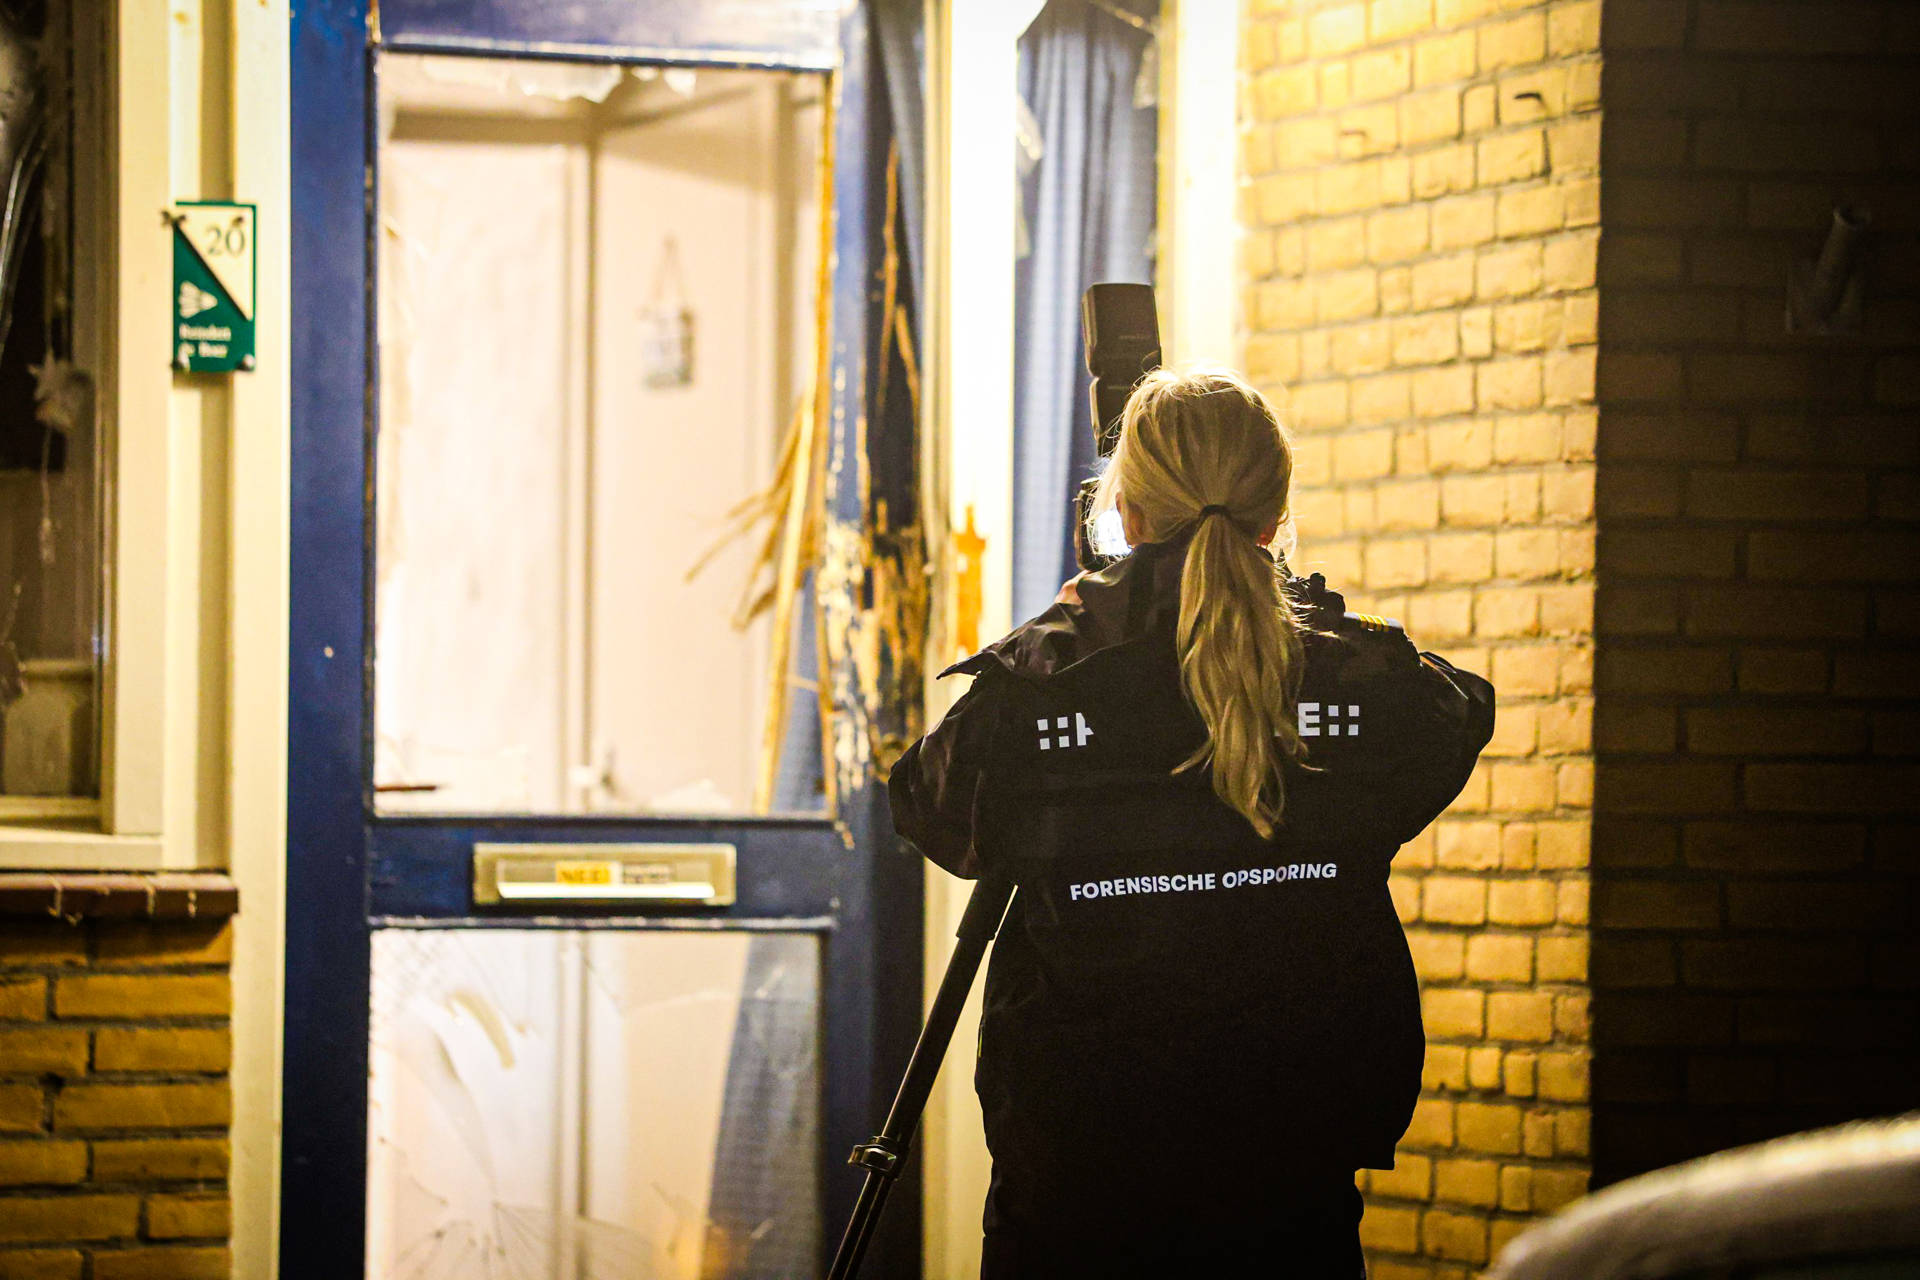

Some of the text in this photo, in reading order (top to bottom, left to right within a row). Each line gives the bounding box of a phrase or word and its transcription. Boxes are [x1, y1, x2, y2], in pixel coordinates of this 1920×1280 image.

[205, 226, 246, 256] 20
[1070, 863, 1338, 901] FORENSISCHE OPSPORING
